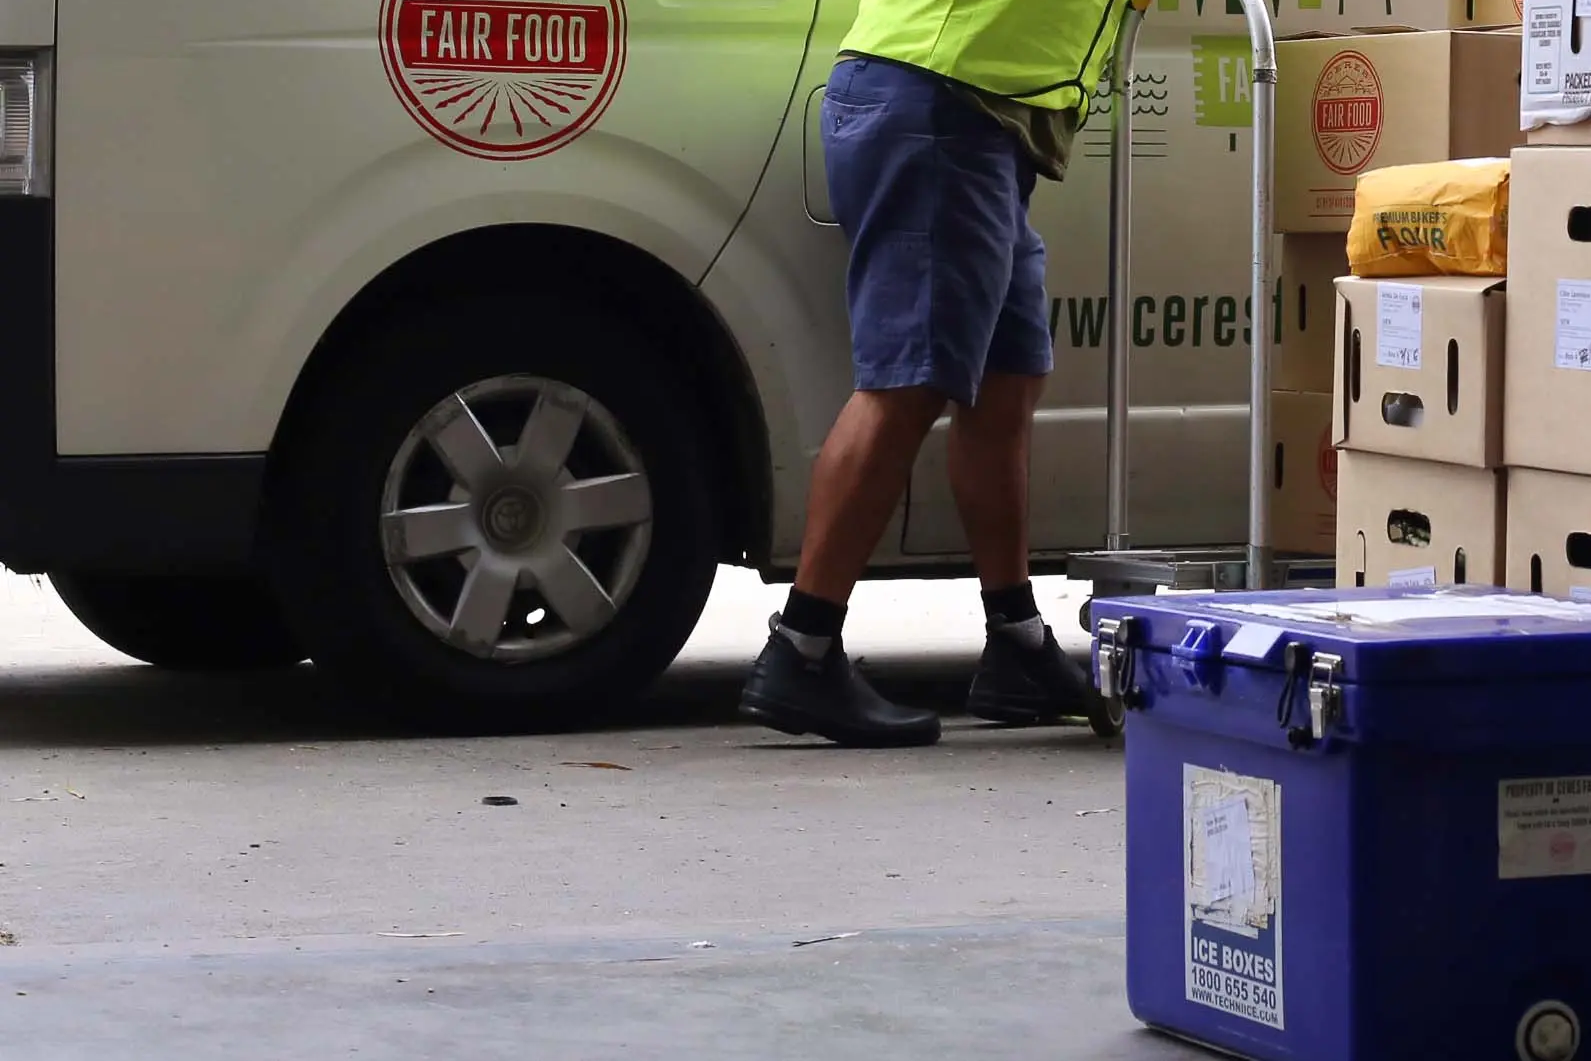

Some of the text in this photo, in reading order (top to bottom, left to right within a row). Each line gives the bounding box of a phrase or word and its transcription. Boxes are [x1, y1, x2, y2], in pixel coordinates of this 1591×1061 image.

[420, 9, 587, 63] FAIR FOOD
[1322, 101, 1372, 128] FAIR FOOD
[1377, 227, 1448, 251] FLOUR
[1193, 936, 1275, 983] ICE BOXES
[1192, 965, 1276, 1010] 1800 655 540
[1192, 987, 1279, 1025] WWW.TECHNIICE.COM
